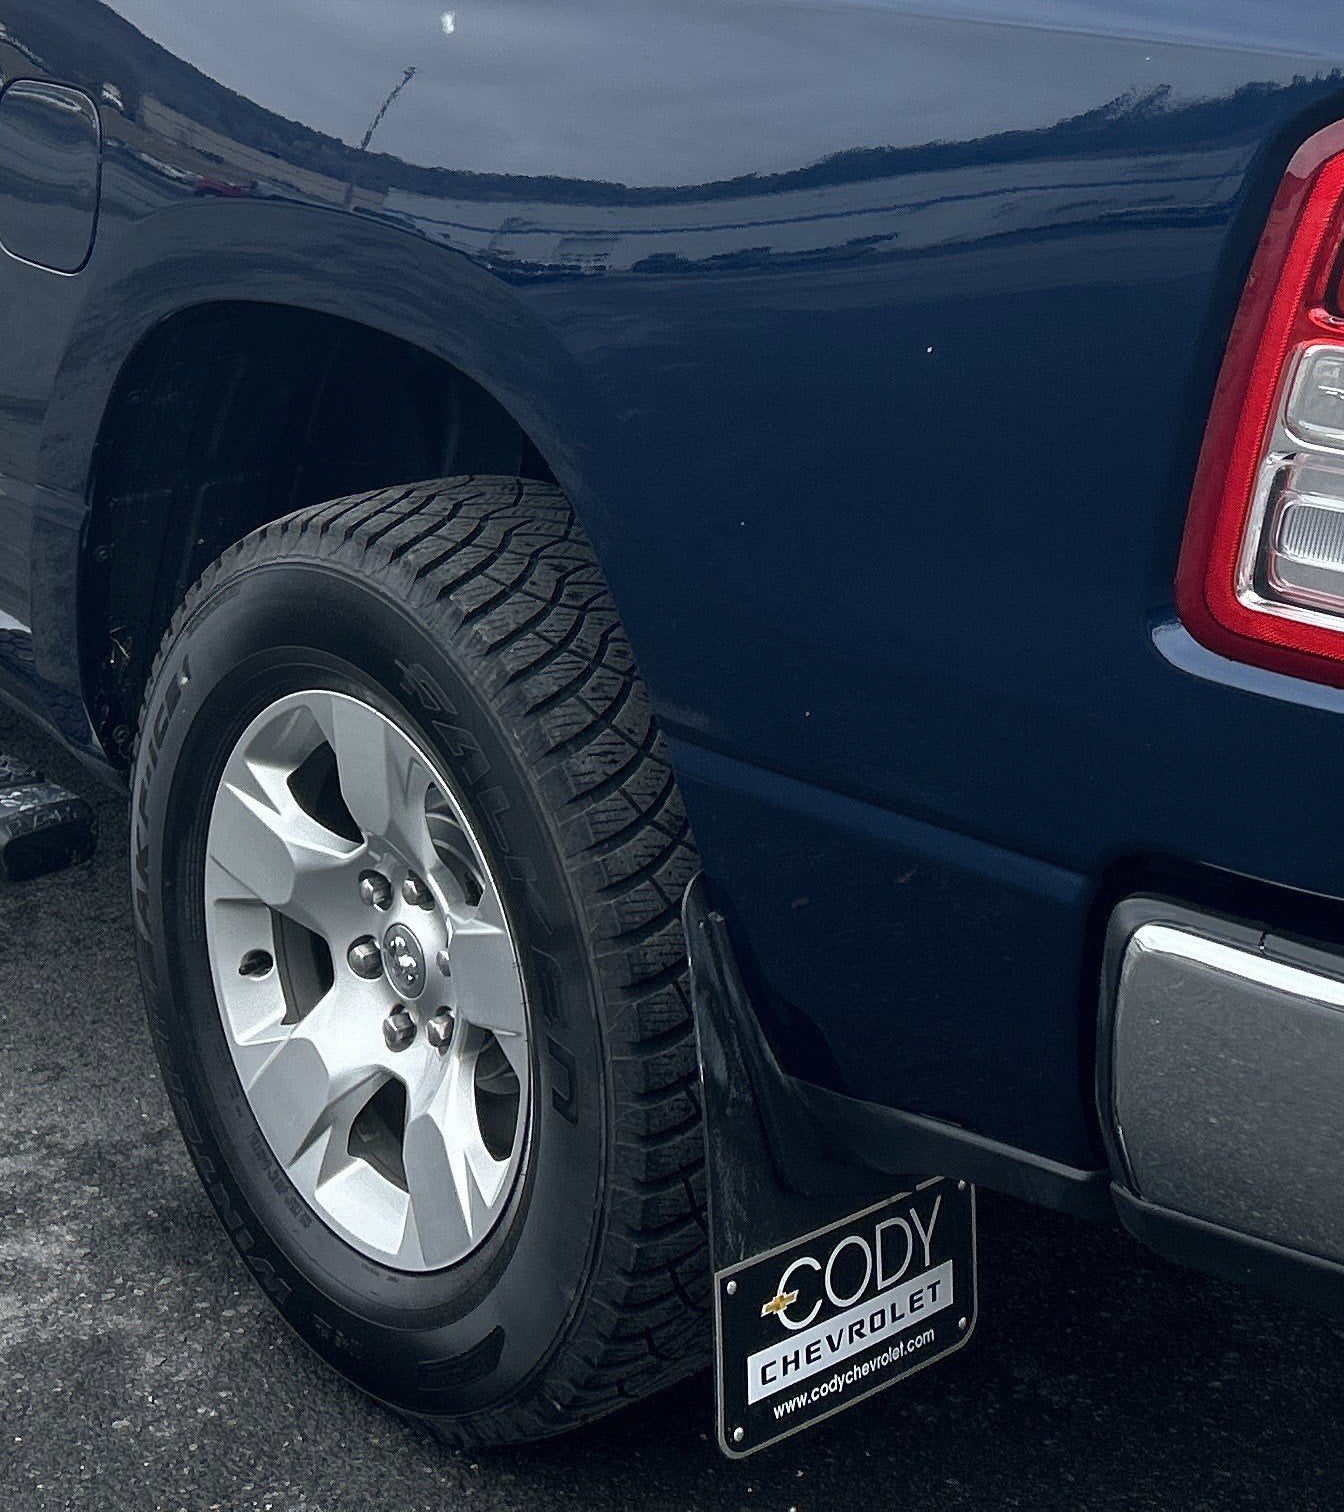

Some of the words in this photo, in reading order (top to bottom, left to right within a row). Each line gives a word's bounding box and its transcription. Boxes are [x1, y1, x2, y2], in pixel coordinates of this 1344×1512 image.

[777, 1195, 942, 1330] CODY
[760, 1279, 941, 1386] CHEVROLET
[773, 1328, 935, 1419] www.codychevrolet.com
